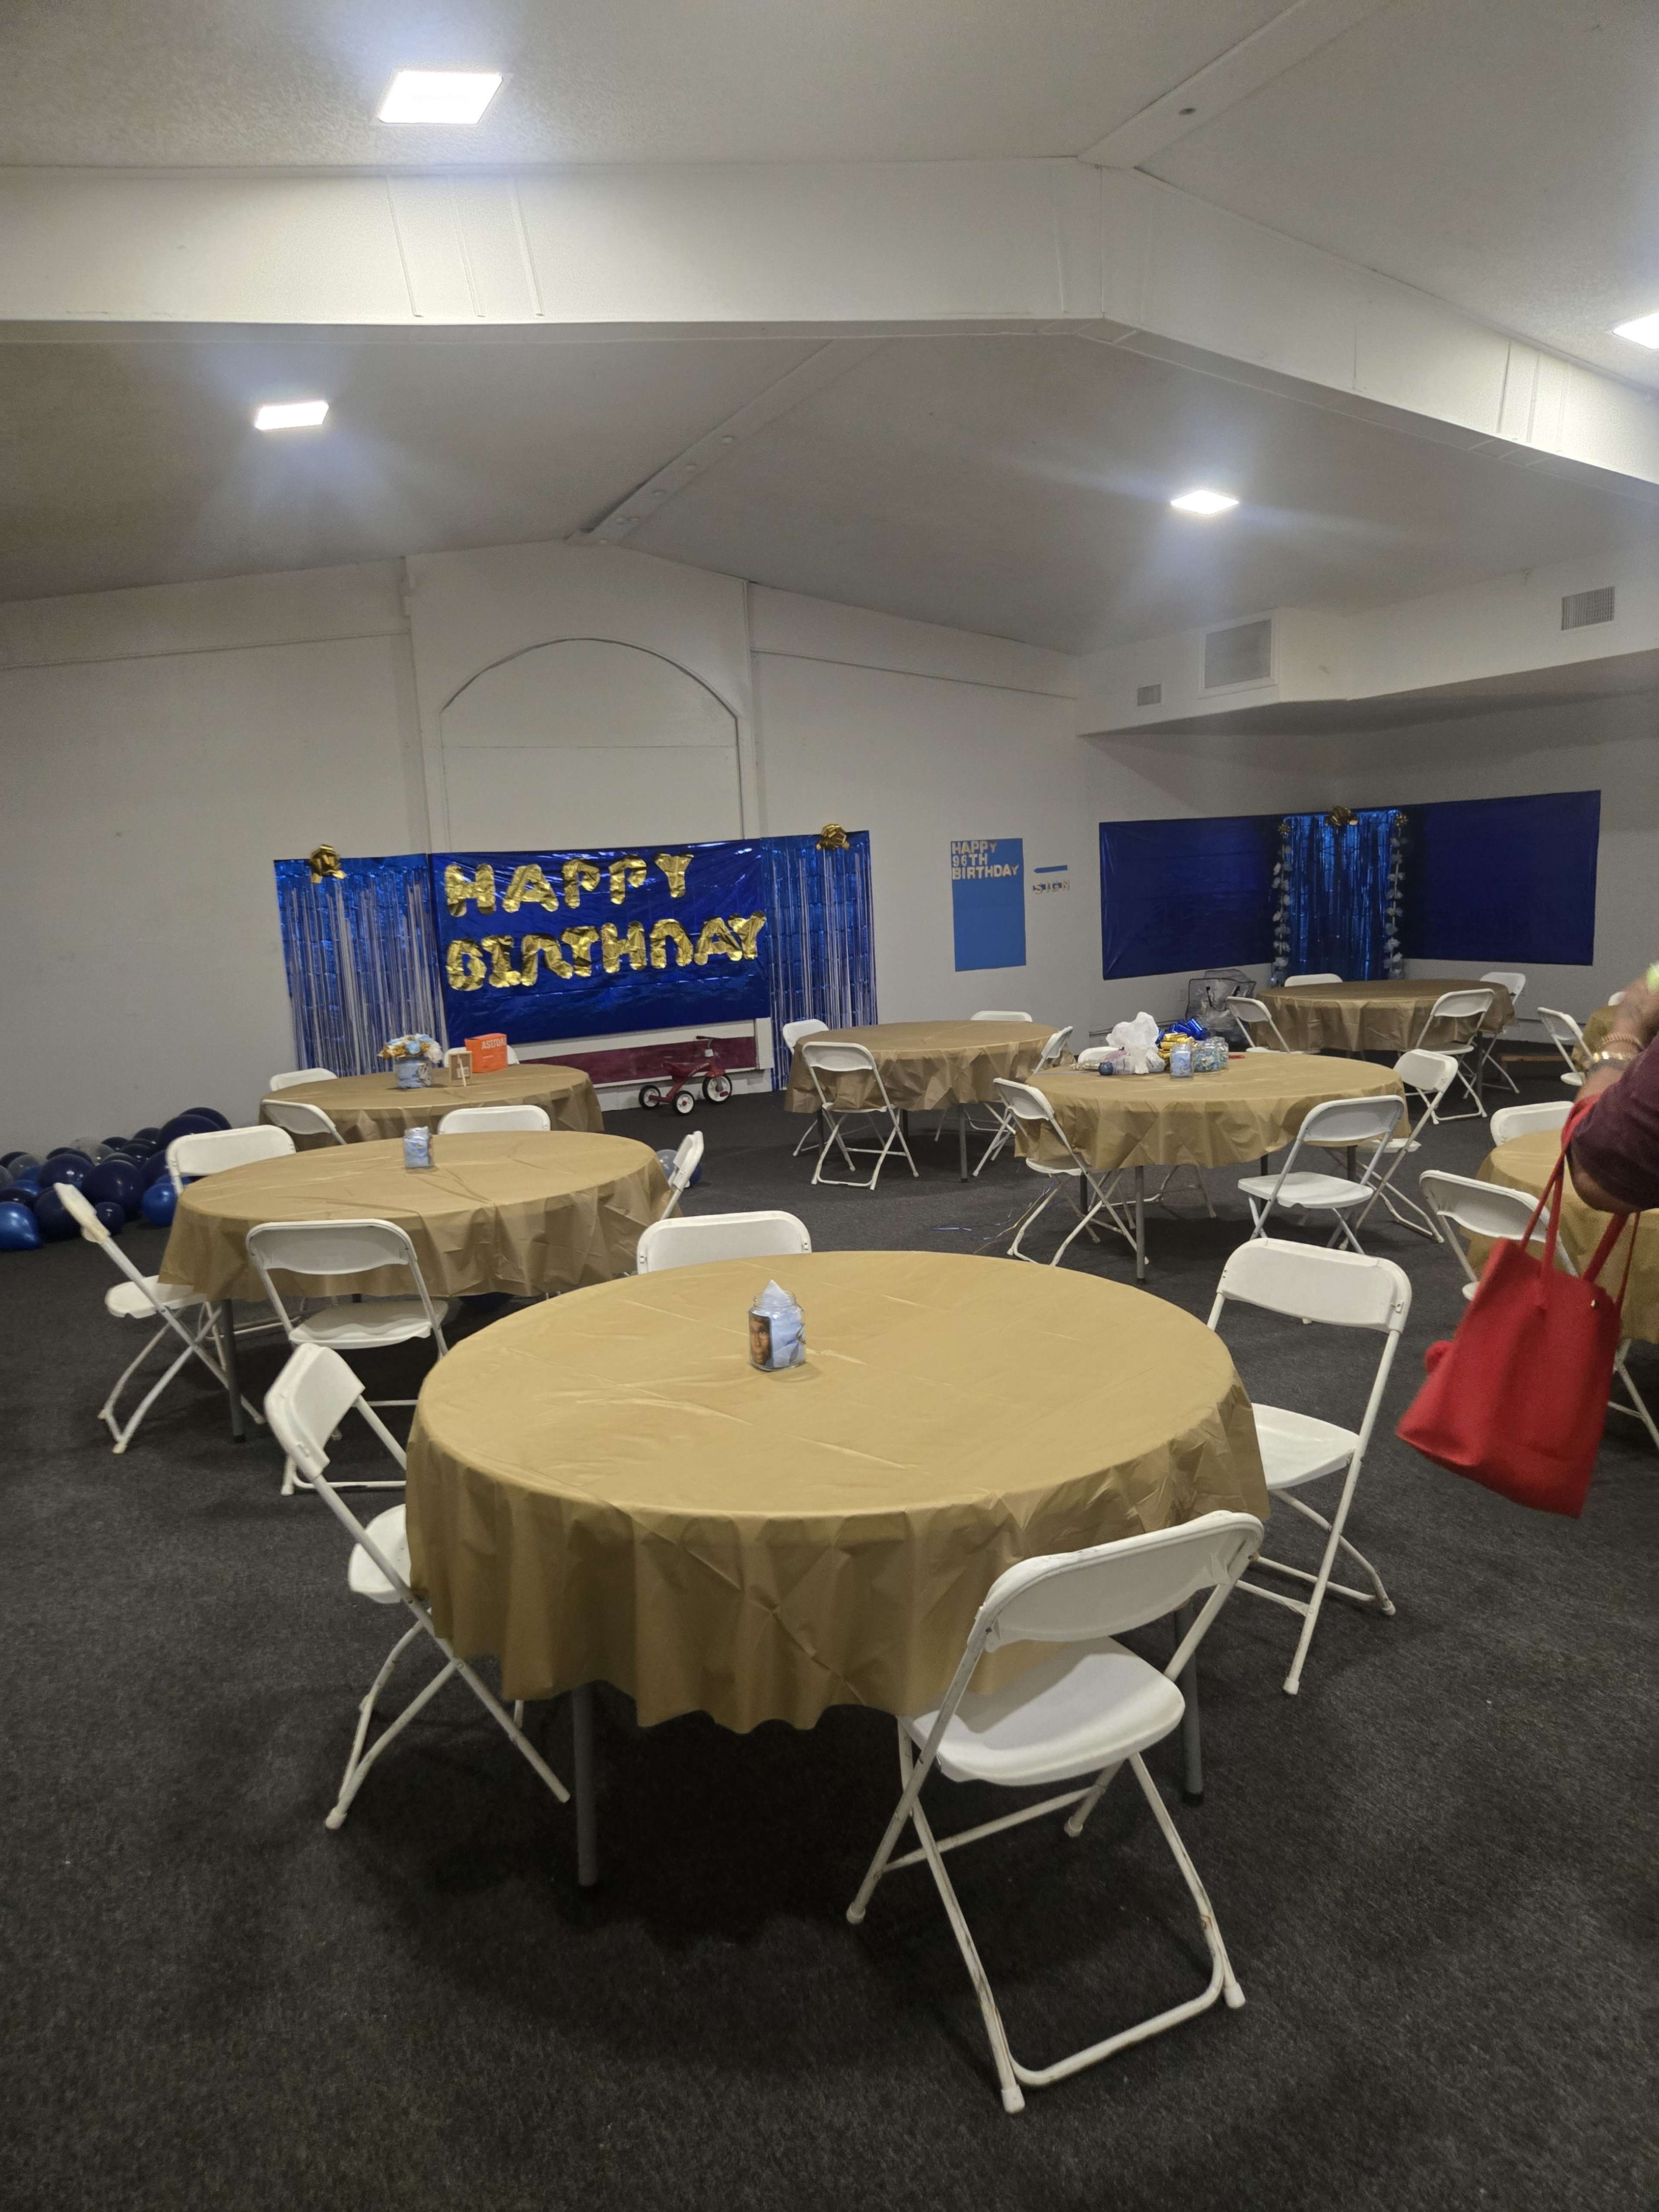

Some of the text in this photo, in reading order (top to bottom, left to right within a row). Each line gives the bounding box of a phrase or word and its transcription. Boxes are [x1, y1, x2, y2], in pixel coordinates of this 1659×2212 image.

[952, 841, 997, 854] HAPPY
[953, 853, 988, 867] 96TH
[952, 864, 1019, 880] BIRTHDAY
[445, 853, 694, 917] HAPPY
